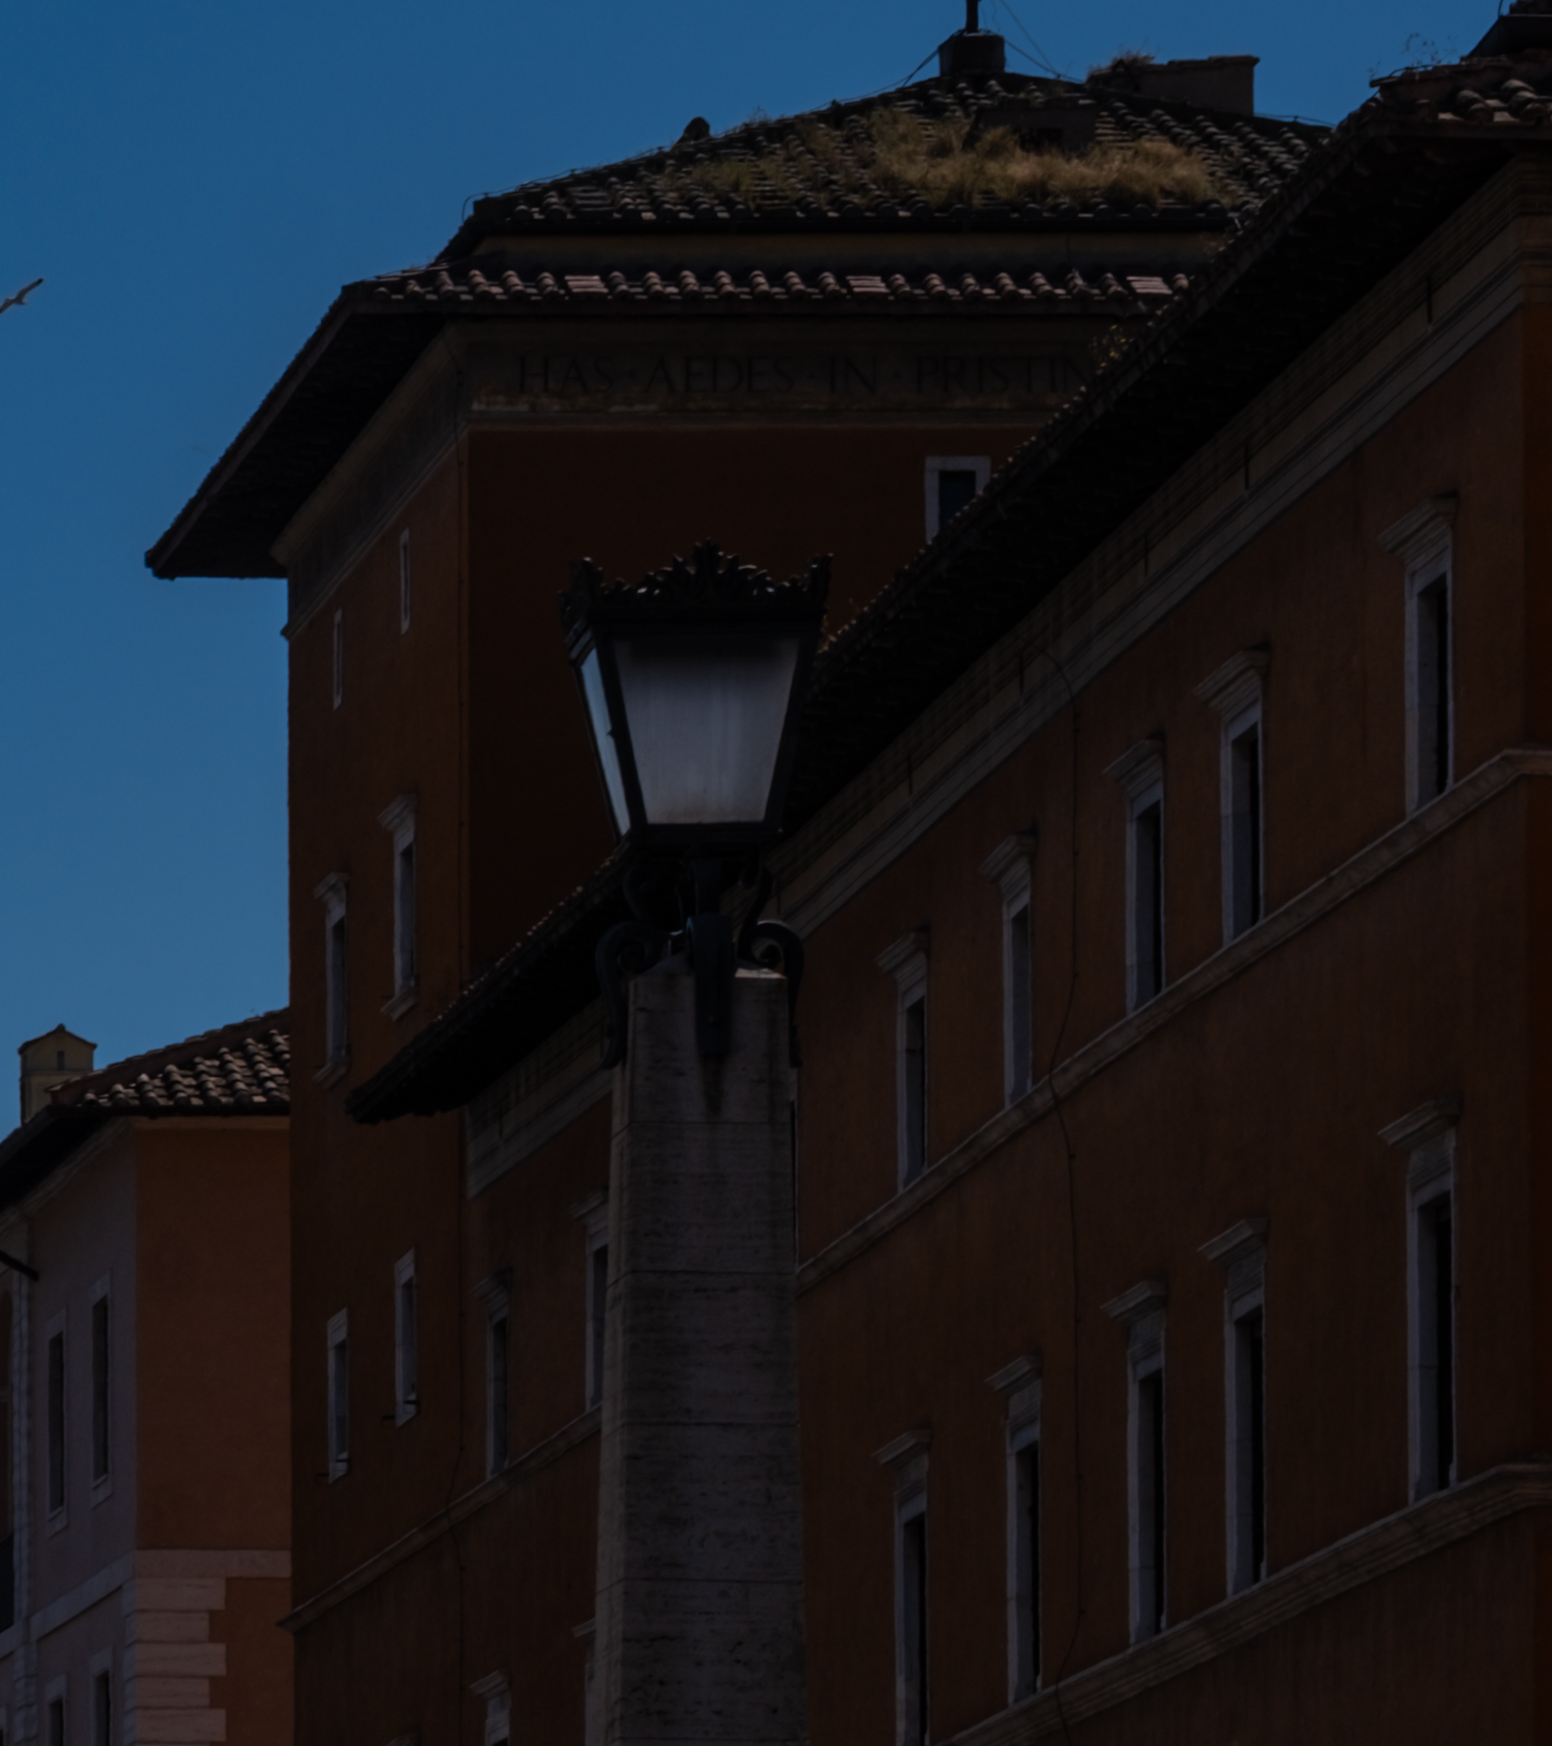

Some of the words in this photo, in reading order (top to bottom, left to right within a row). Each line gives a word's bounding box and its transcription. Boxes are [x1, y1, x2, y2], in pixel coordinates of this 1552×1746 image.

[519, 355, 614, 393] HAS
[645, 355, 794, 393] AEDES
[830, 355, 878, 393] IN
